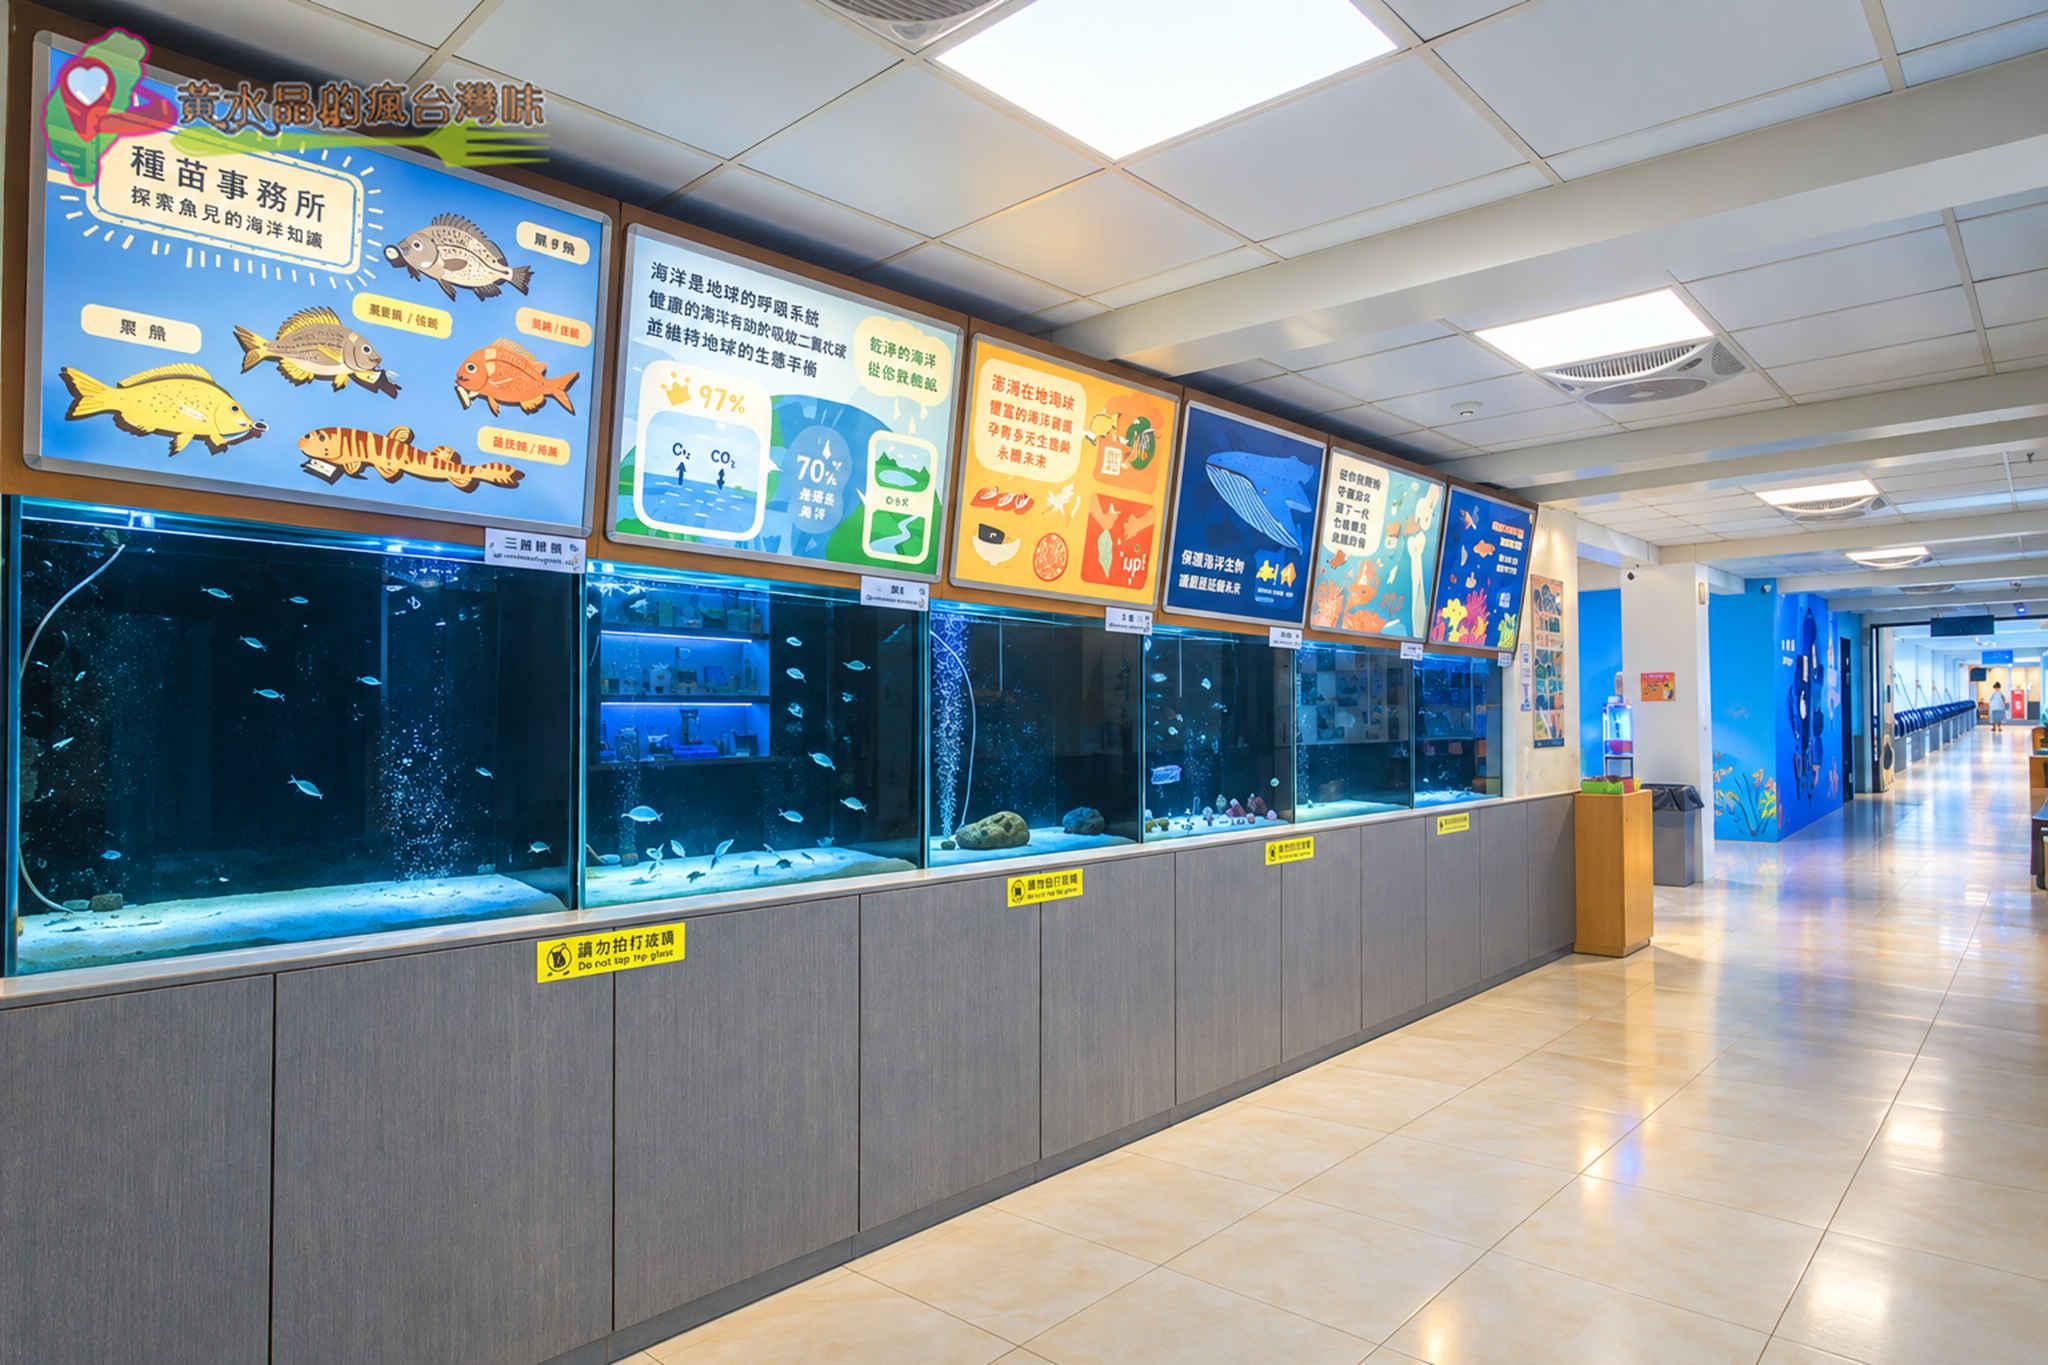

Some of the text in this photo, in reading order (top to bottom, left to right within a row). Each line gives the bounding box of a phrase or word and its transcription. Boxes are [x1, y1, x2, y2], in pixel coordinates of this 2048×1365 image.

[131, 145, 325, 222] 種苗事務所
[699, 385, 745, 414] 97%
[578, 930, 674, 958] 請勿拍打玻璃
[578, 961, 593, 970] Do
[595, 958, 612, 968] not
[614, 956, 630, 966] tap
